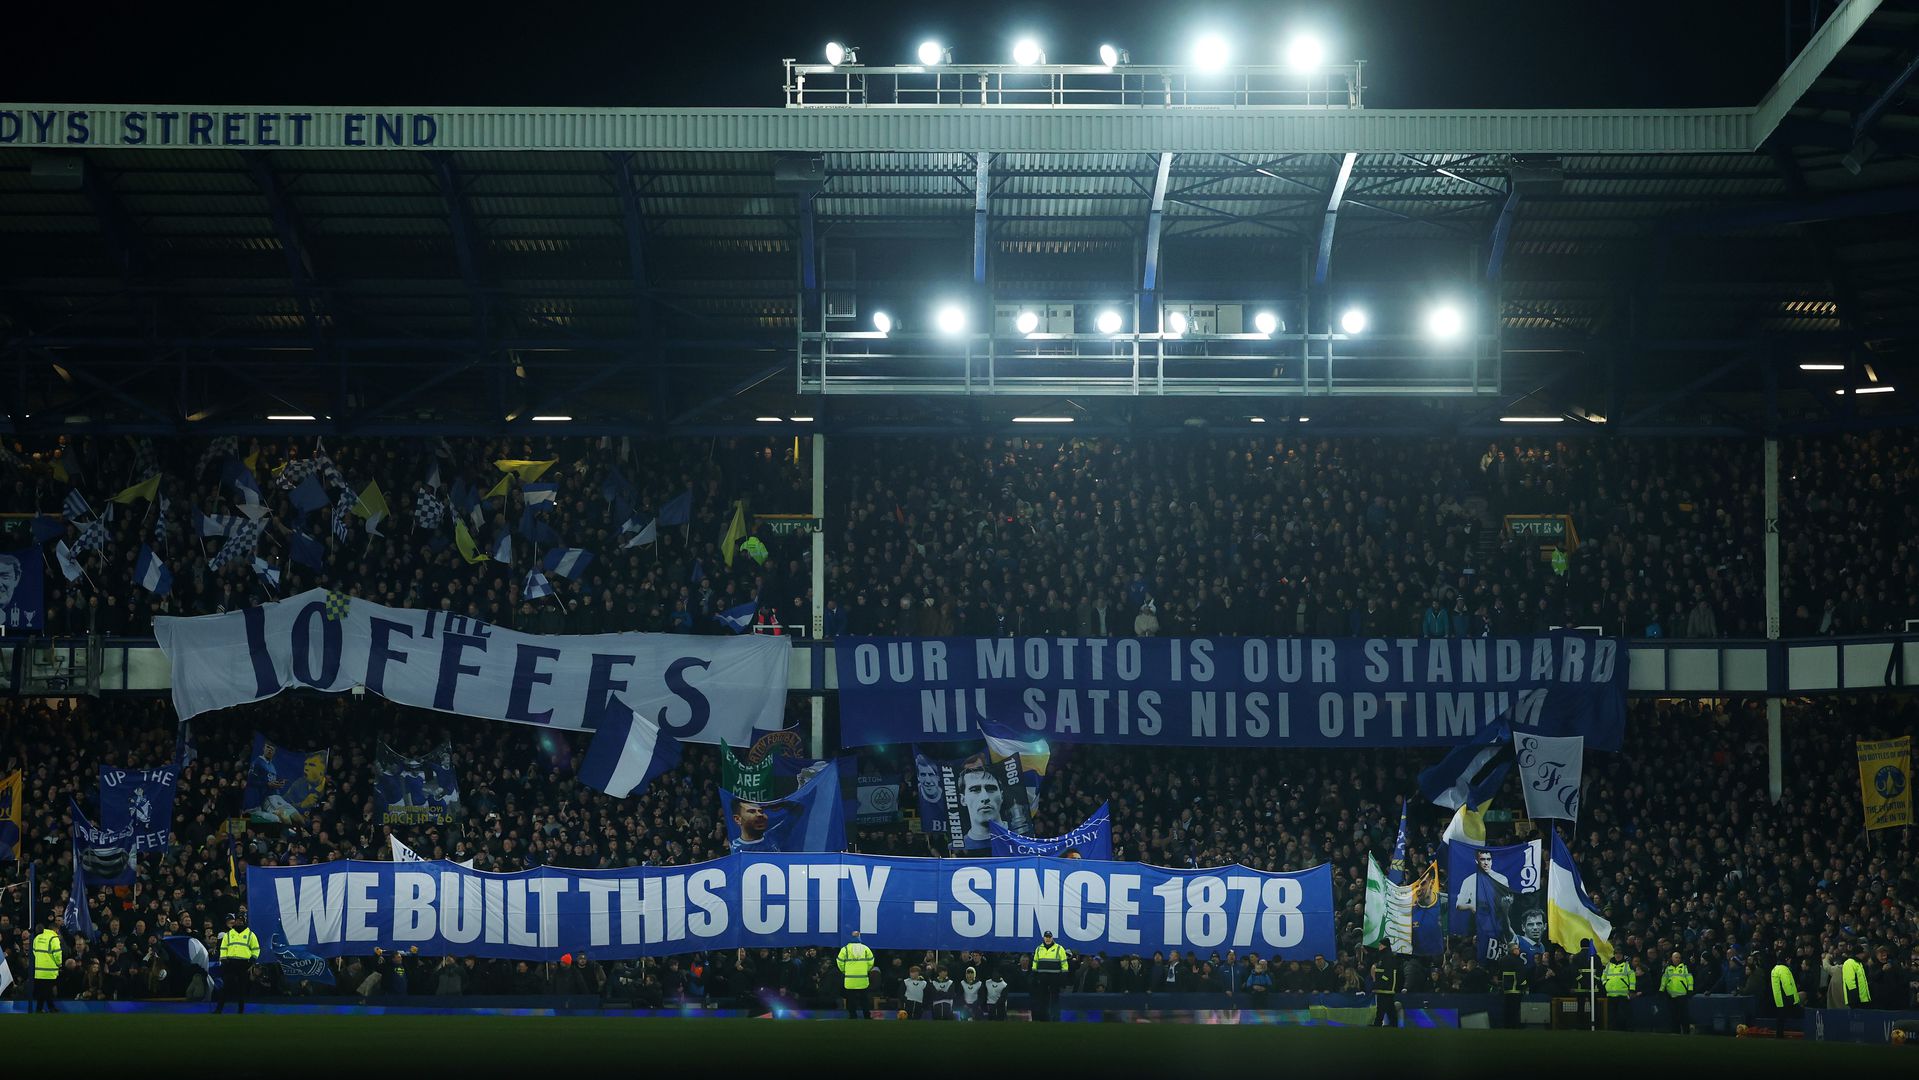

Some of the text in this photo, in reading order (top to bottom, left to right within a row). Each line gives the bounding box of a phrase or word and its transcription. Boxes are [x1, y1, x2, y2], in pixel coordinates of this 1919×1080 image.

[123, 111, 312, 146] STREET
[344, 113, 438, 147] END
[769, 522, 792, 534] XIT
[1511, 522, 1542, 534] EXIT
[1766, 519, 1778, 533] K
[854, 636, 1618, 685] OUR MOTTO IS OUR STANDARD
[1023, 687, 1163, 736] SATIS
[1191, 691, 1290, 738] NISI
[1318, 687, 1549, 738] OPTIMUM
[103, 769, 174, 788] UP THE
[737, 773, 761, 787] ARE
[1003, 757, 1020, 786] 1966
[732, 785, 768, 801] MAGIC
[941, 765, 966, 849] DEREK TEMPLE
[1064, 830, 1099, 848] DENY
[1520, 845, 1537, 893] 19
[274, 863, 1303, 948] WE BUILT THIS CITY - SINCE 1878
